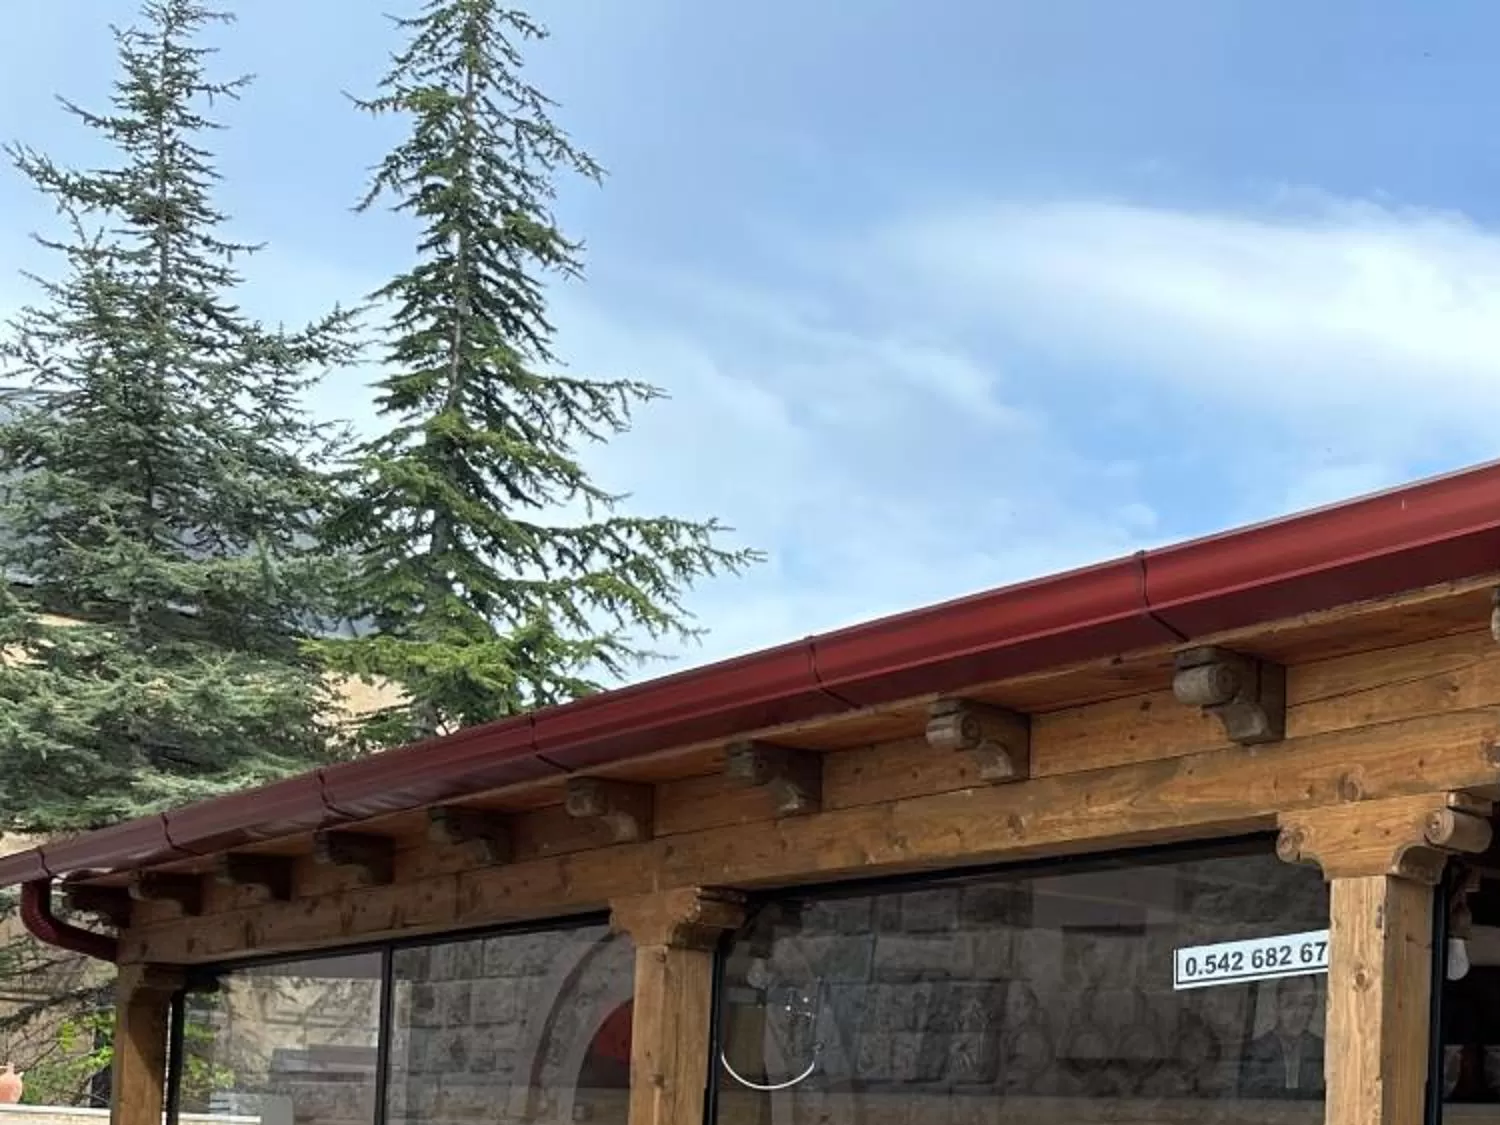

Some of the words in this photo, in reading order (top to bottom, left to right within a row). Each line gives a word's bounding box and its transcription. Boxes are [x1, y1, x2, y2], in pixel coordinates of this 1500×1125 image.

[1185, 951, 1244, 976] 0.542
[1251, 946, 1292, 969] 682
[1300, 941, 1328, 963] 67
